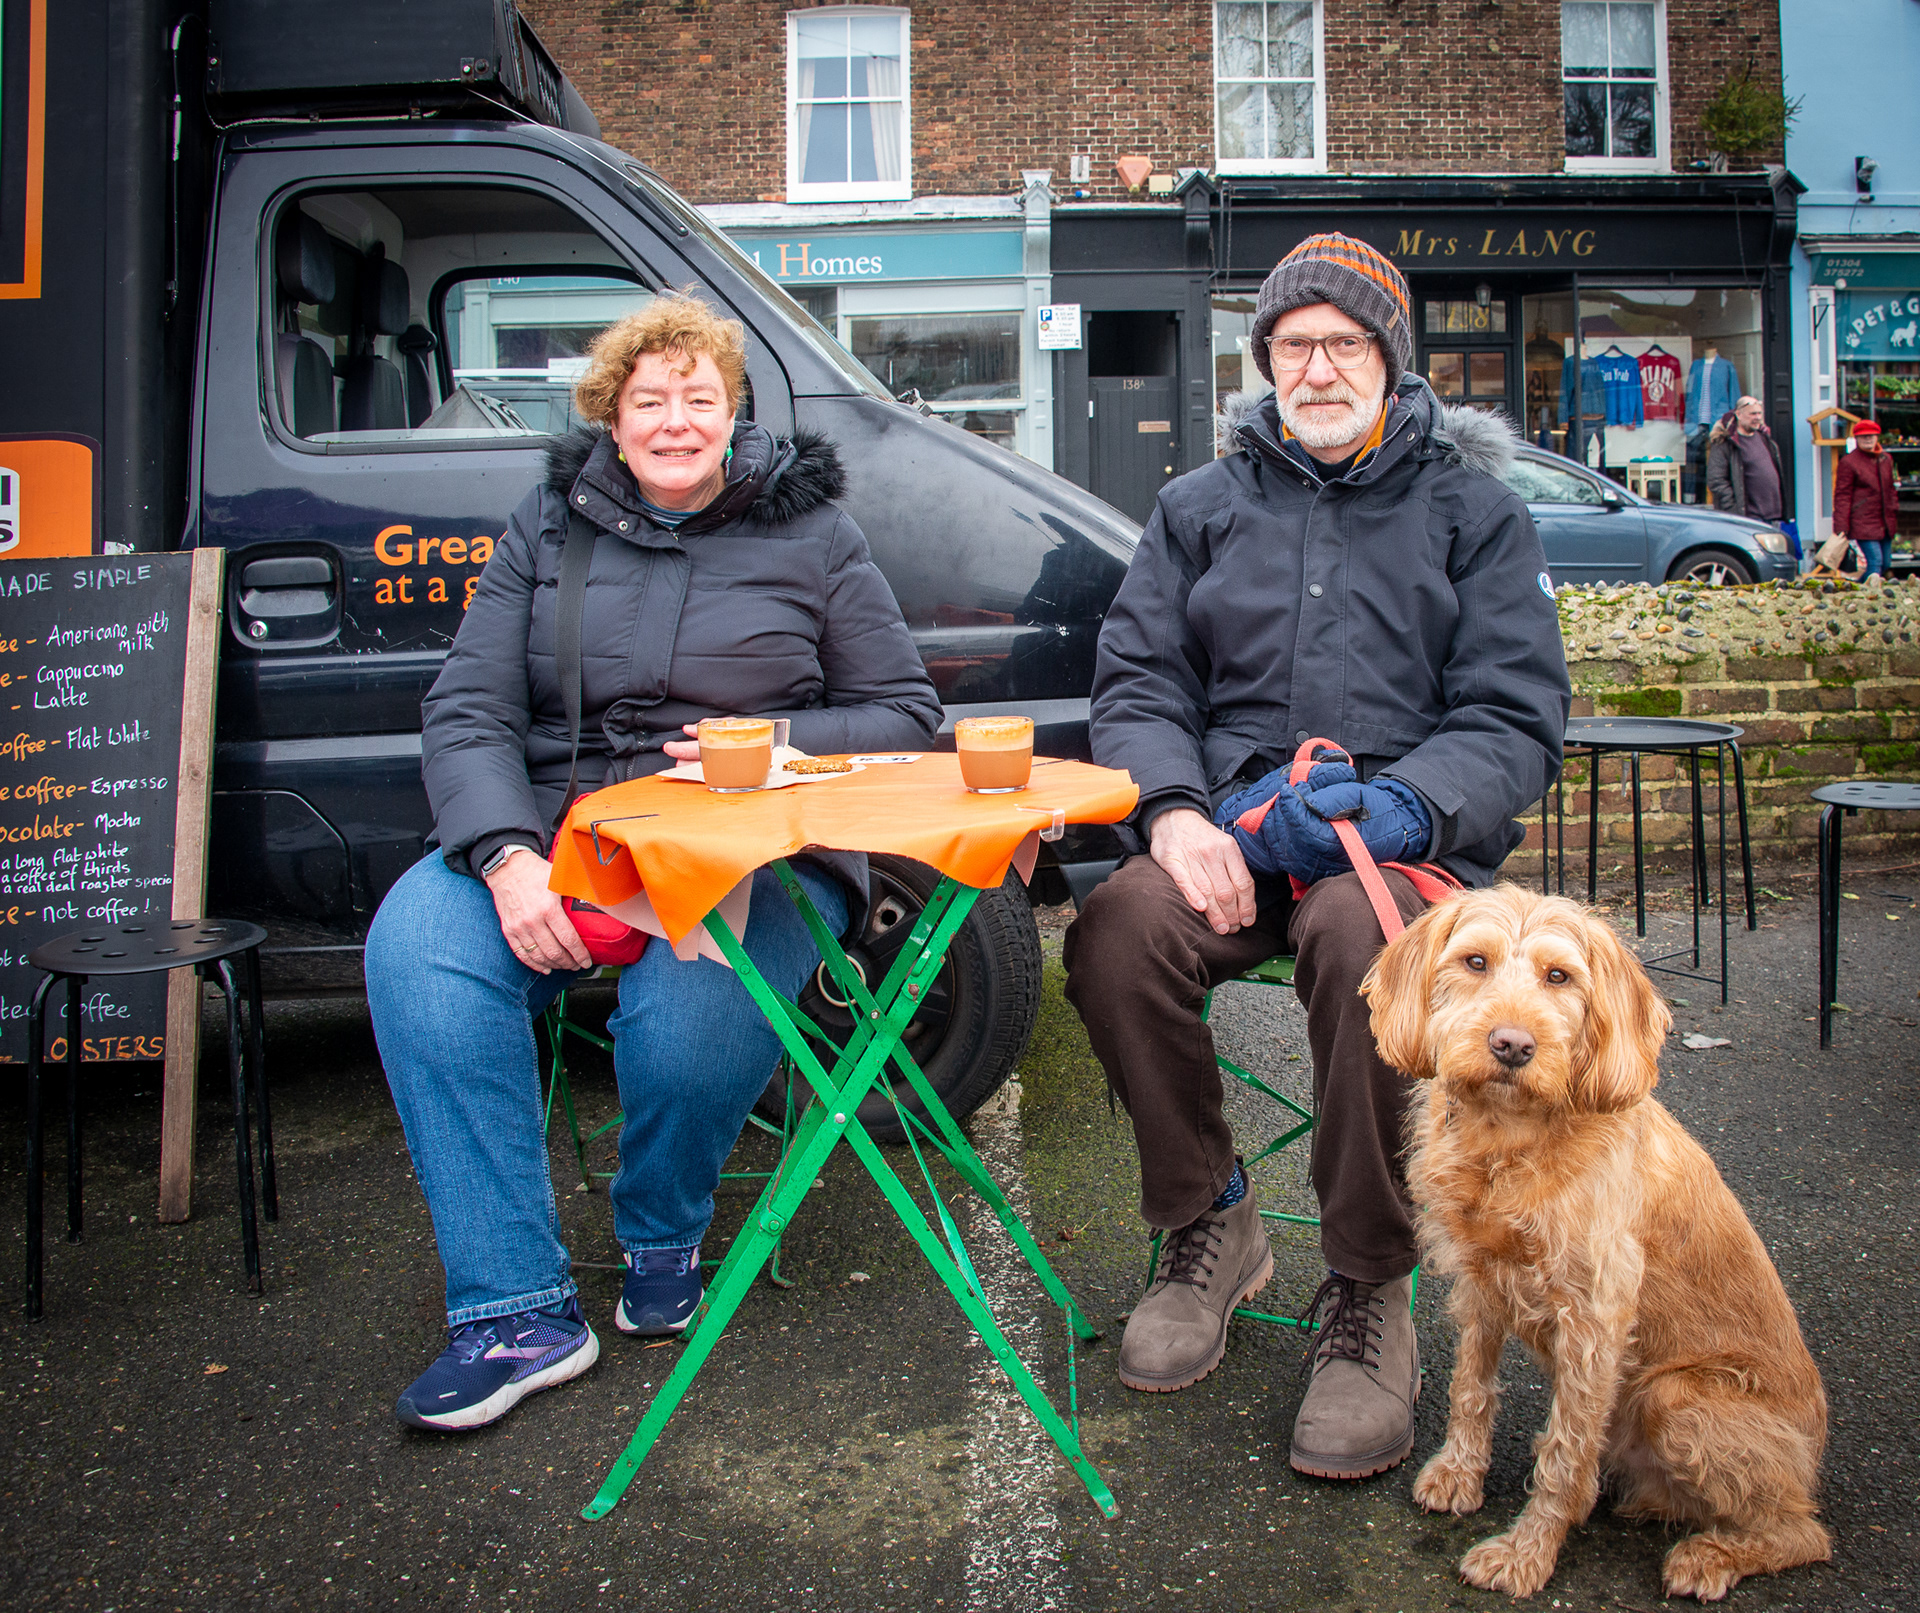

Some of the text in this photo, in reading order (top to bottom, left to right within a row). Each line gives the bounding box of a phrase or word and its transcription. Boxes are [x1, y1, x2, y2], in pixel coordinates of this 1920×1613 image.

[1389, 229, 1597, 256] Mrs LANG
[776, 243, 883, 276] Homes
[1827, 258, 1861, 267] 01304
[1823, 268, 1865, 277] 375272
[1851, 304, 1886, 336] PET
[1890, 300, 1904, 317] &
[1123, 379, 1145, 390] 138A
[374, 524, 495, 566] Grea
[73, 565, 151, 590] SIMPLE
[375, 574, 414, 604] at
[428, 577, 449, 603] a
[46, 624, 128, 647] Americano
[136, 610, 169, 635] with
[37, 664, 124, 690] Cappuccino
[33, 686, 90, 709] Latte
[67, 726, 102, 749] Flat
[90, 777, 168, 797] Espresso
[94, 811, 142, 834] Mocha
[1, 840, 130, 874] a long flat white
[1, 860, 131, 892] a coffee of thirds
[3, 884, 13, 894] a
[17, 881, 42, 894] real
[80, 874, 133, 893] roaster
[43, 901, 80, 923] not
